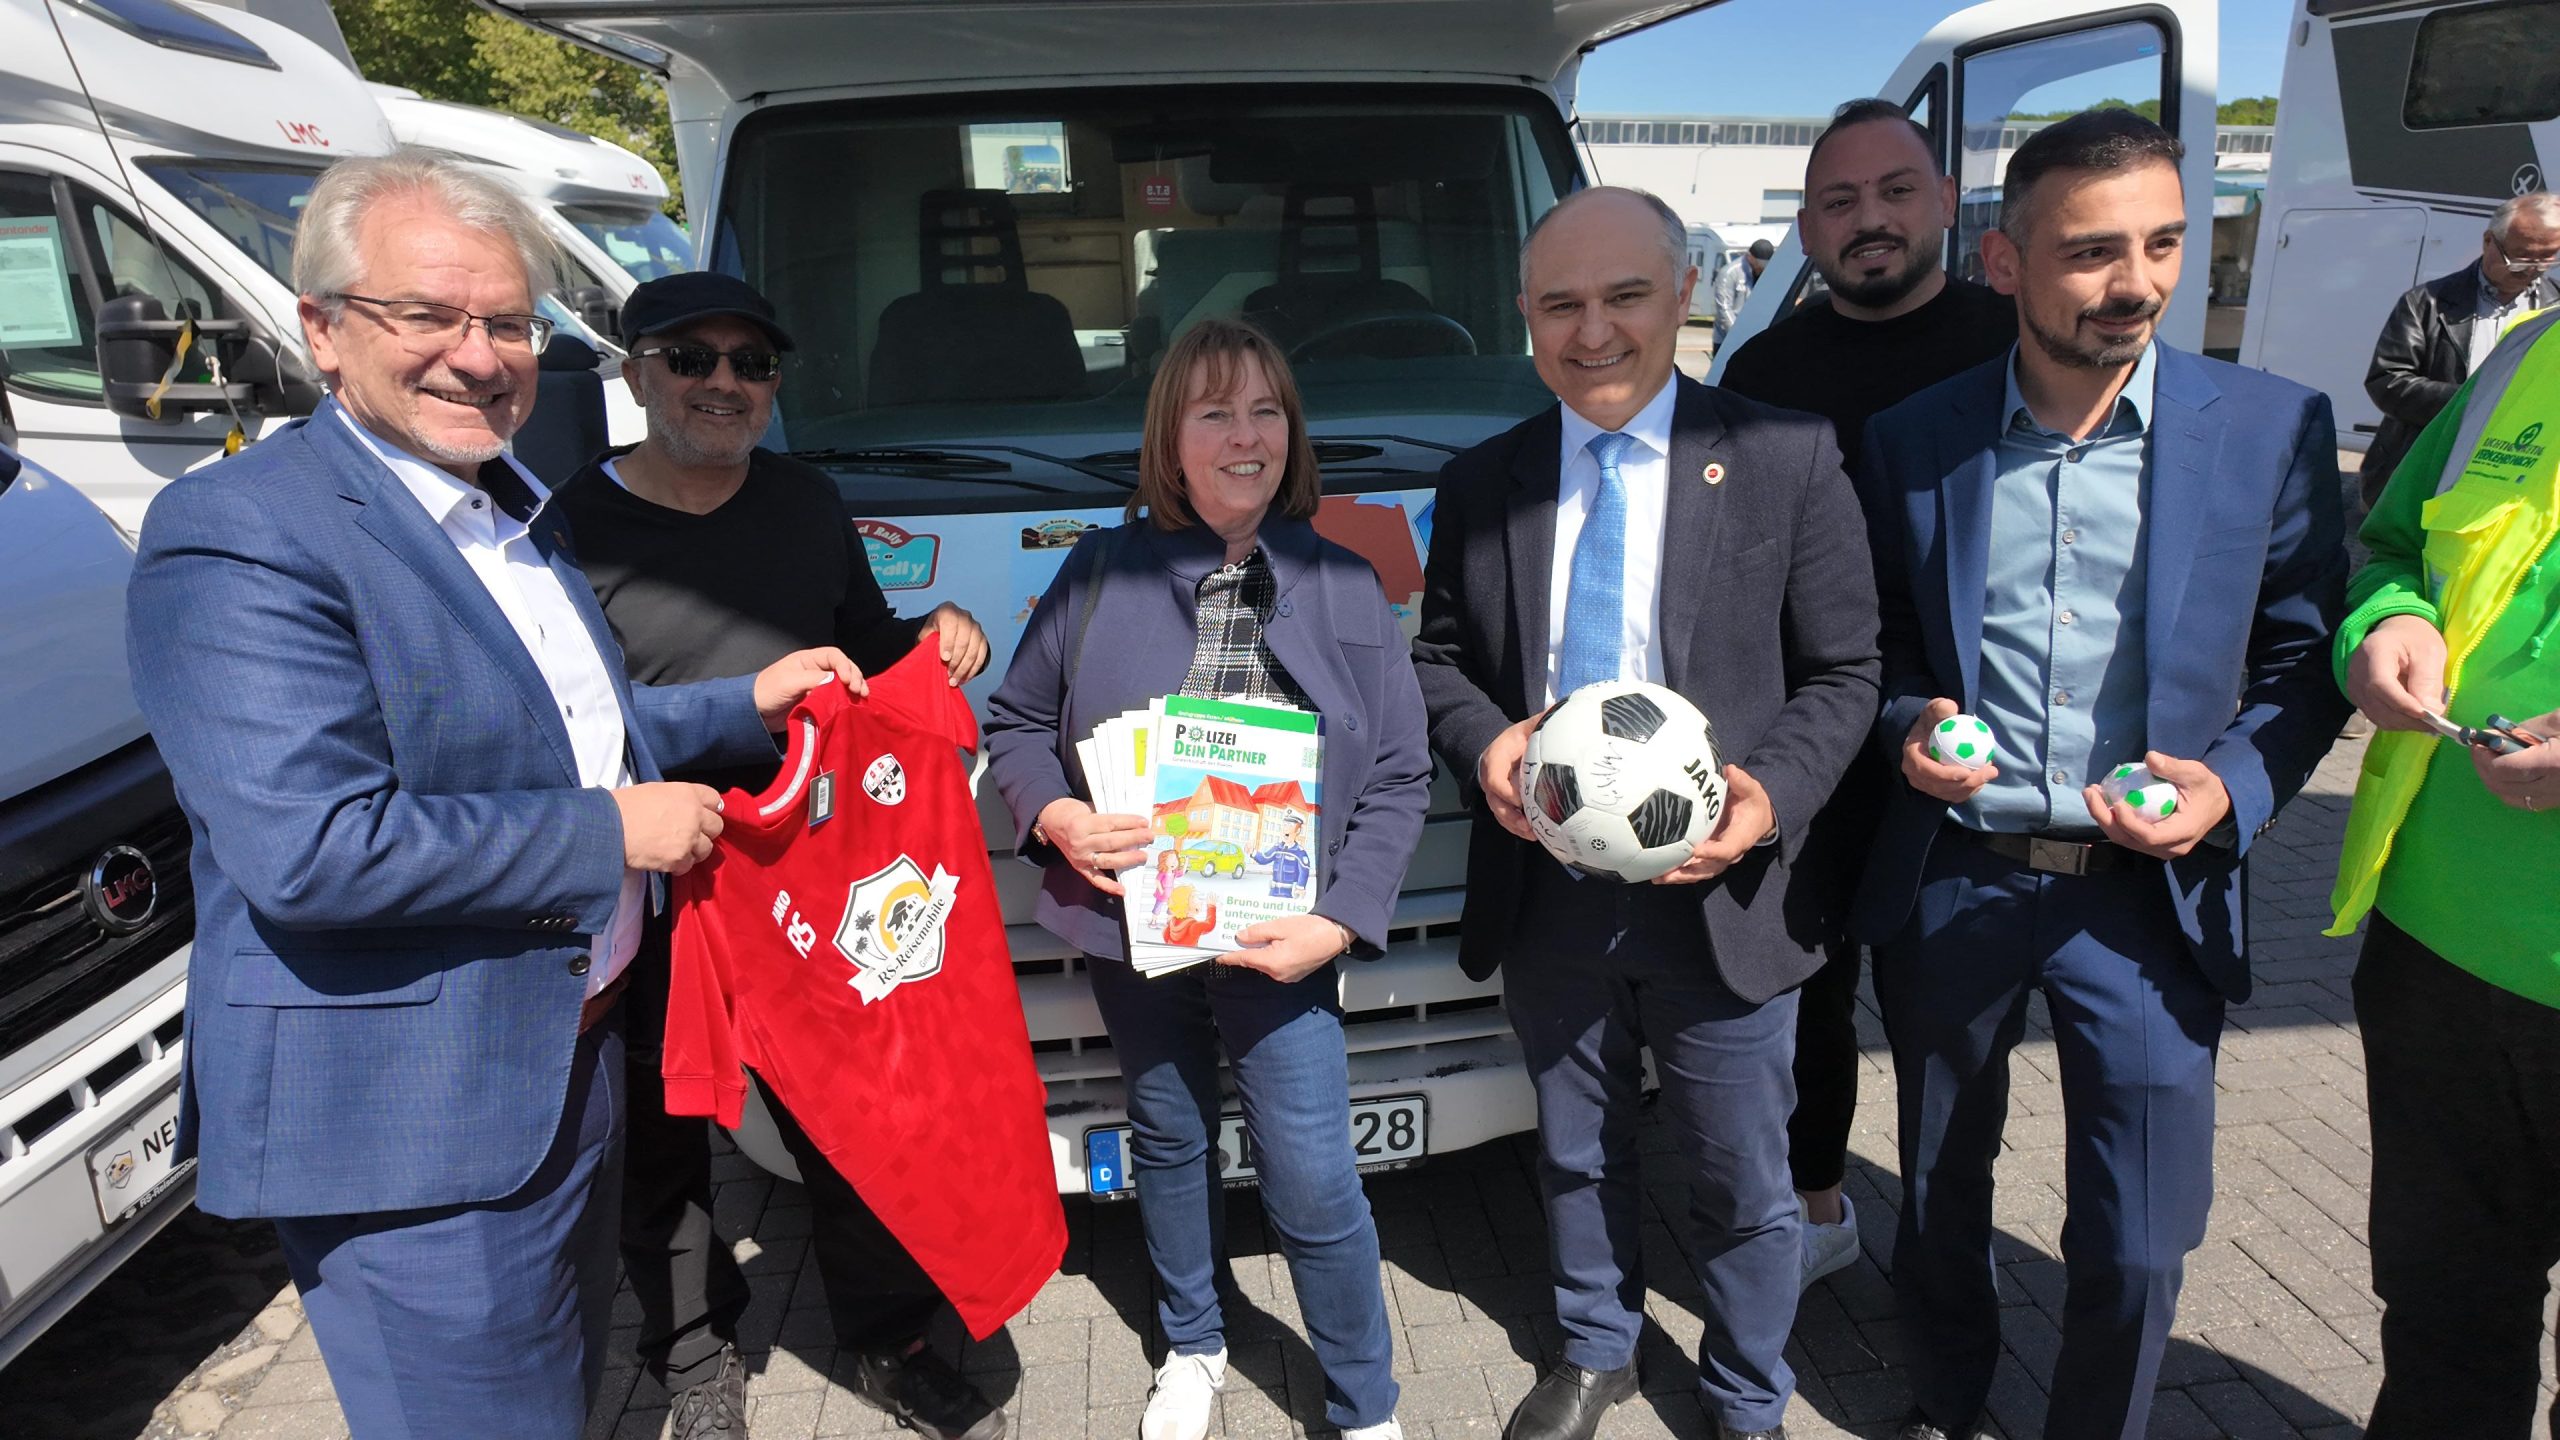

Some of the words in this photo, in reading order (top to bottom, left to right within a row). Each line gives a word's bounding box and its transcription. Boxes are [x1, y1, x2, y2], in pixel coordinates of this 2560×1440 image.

[276, 120, 329, 147] LMC
[0, 224, 49, 236] antander
[873, 526, 903, 545] Rally
[1209, 744, 1267, 766] PARTNER
[1684, 758, 1720, 821] JAKO
[103, 867, 150, 909] LMC
[1226, 896, 1260, 908] Bruno
[1263, 902, 1284, 910] und
[1287, 902, 1308, 912] Lisa
[787, 911, 817, 960] RS
[877, 898, 946, 985] RS-Reisemobile
[1353, 1108, 1416, 1156] 28
[1100, 1167, 1112, 1181] D
